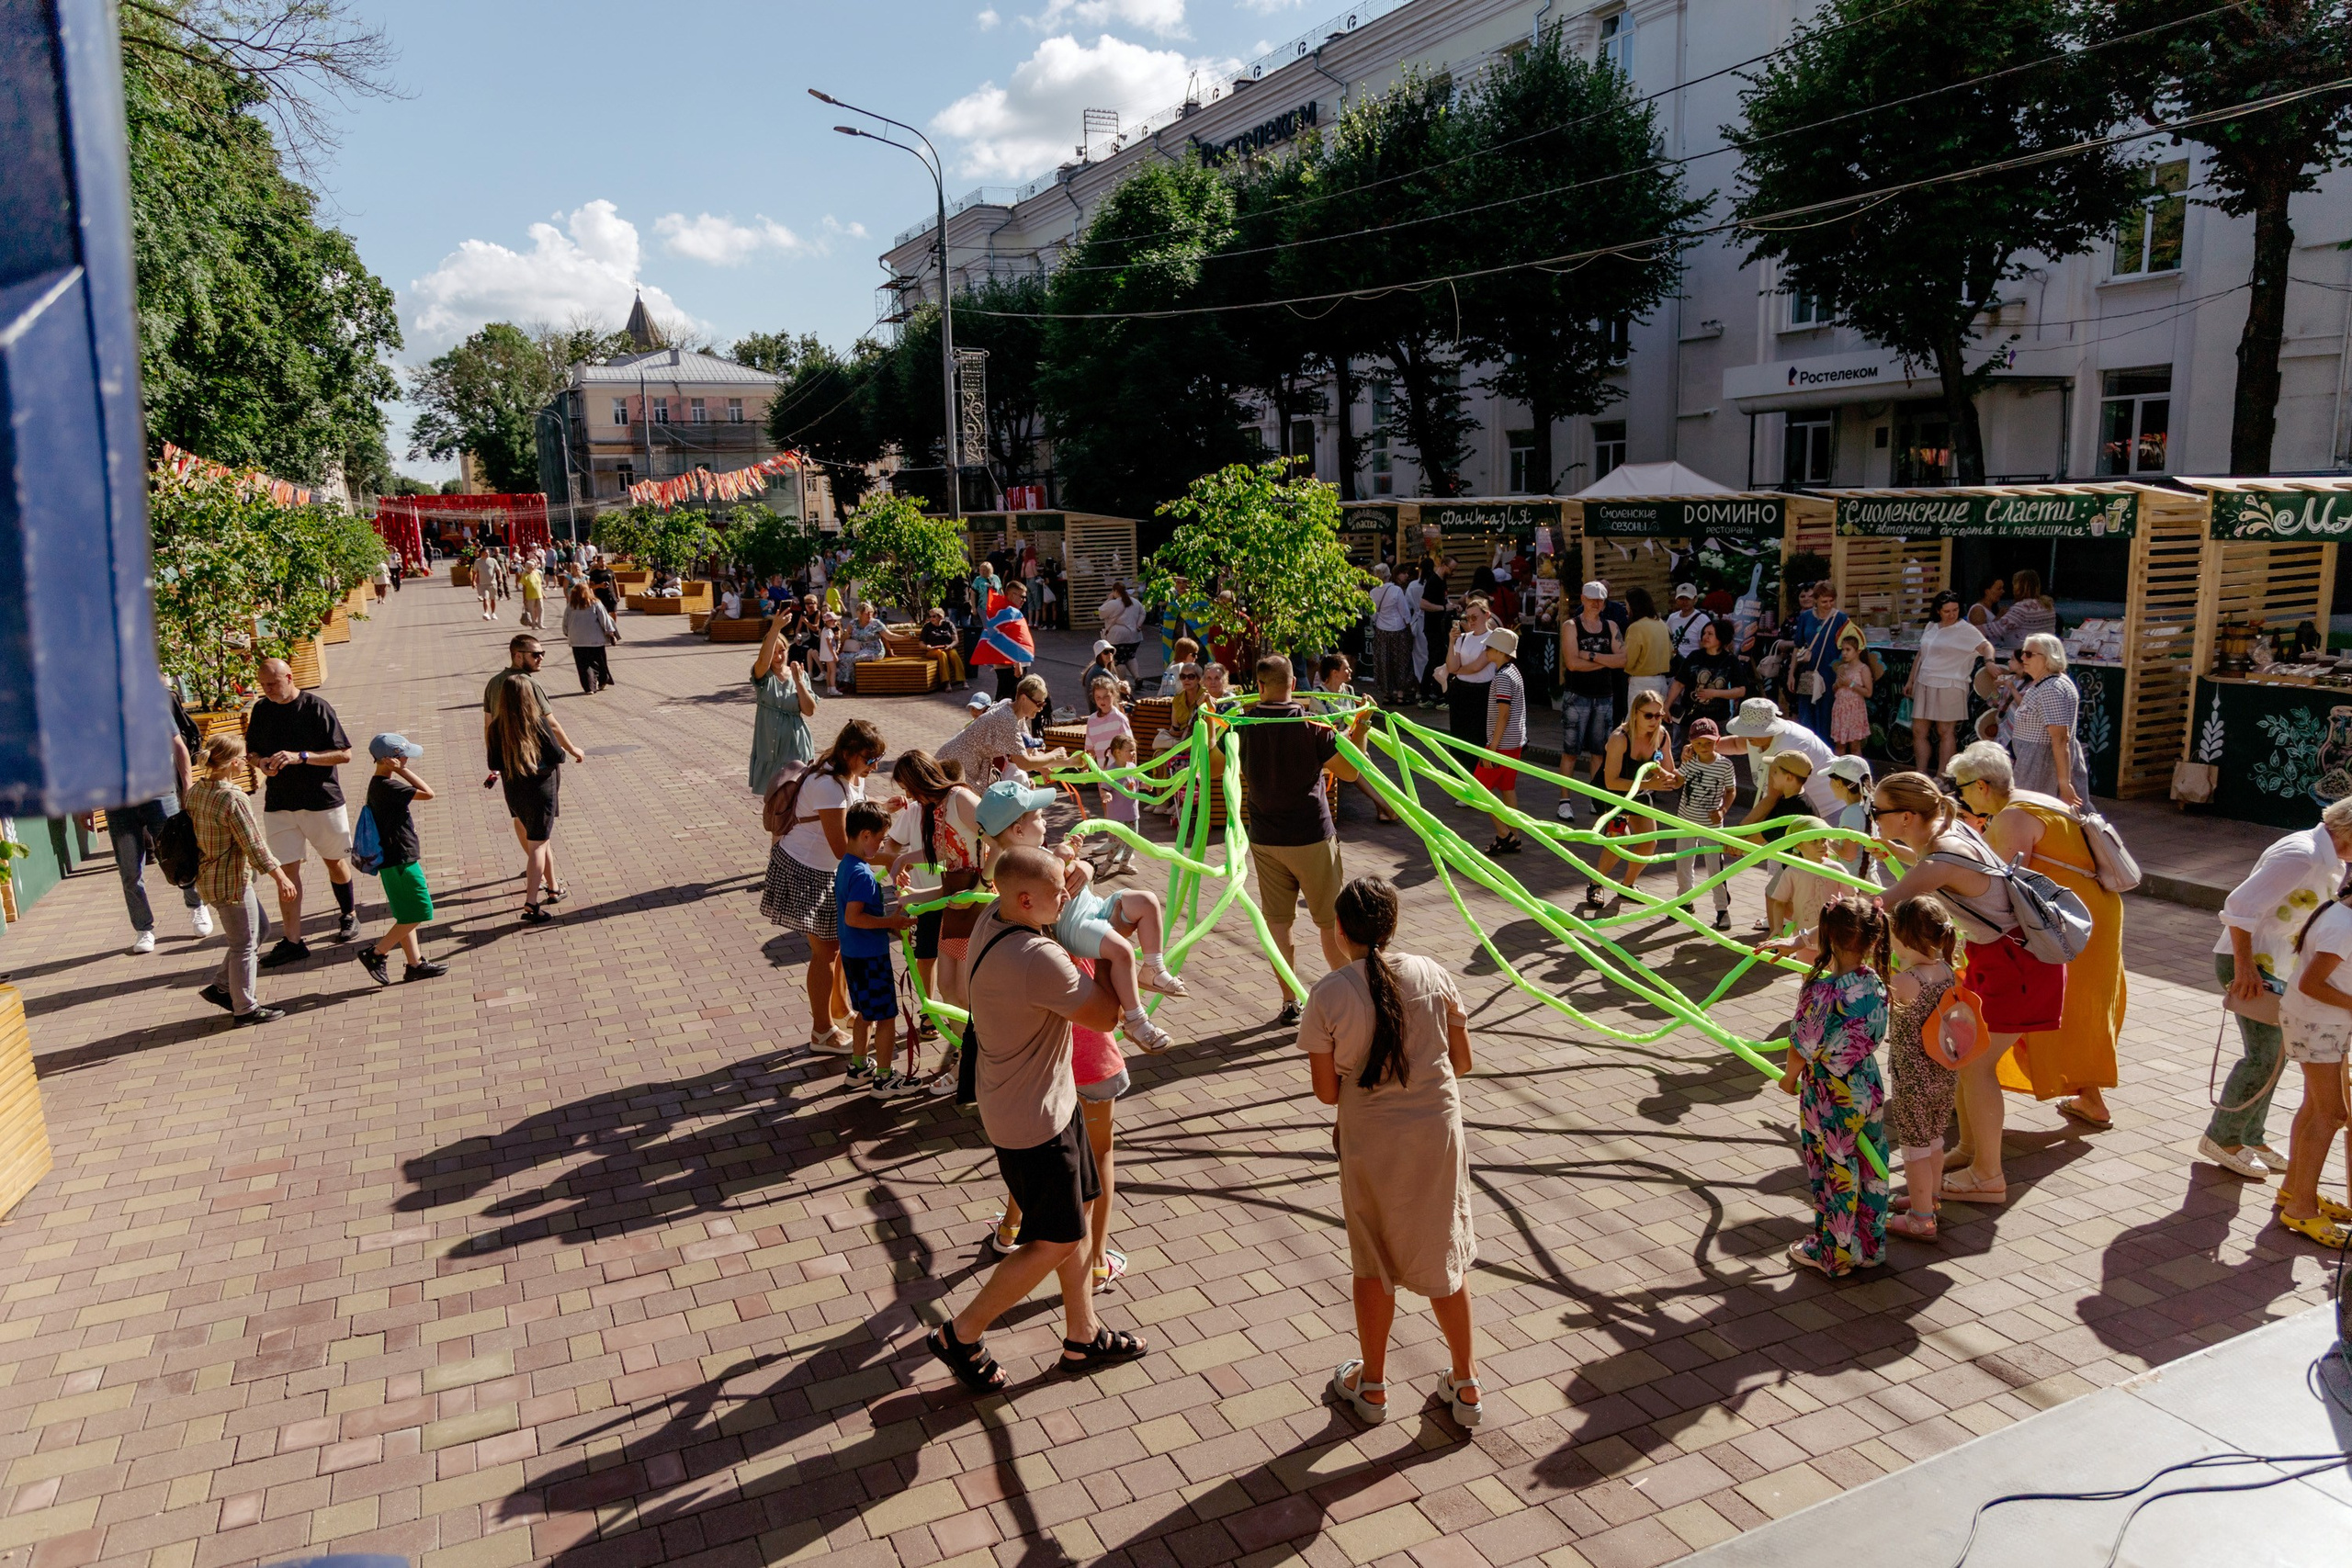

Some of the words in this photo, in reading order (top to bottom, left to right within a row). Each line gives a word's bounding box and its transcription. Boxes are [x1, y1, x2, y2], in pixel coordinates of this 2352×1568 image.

[1201, 101, 1317, 169] Ростелеком
[1800, 367, 1878, 384] Ростелеком
[1441, 505, 1532, 533] Фантазия
[1600, 506, 1657, 519] Смоленские
[1846, 500, 1970, 524] Смоленские
[1985, 499, 2075, 523] Сласти
[1611, 521, 1646, 531] сезоны
[1706, 526, 1753, 535] рестораны
[1875, 524, 1932, 536] авторские
[1939, 523, 1995, 537] десерты
[1998, 525, 2007, 536] и
[2013, 525, 2074, 536] пряники
